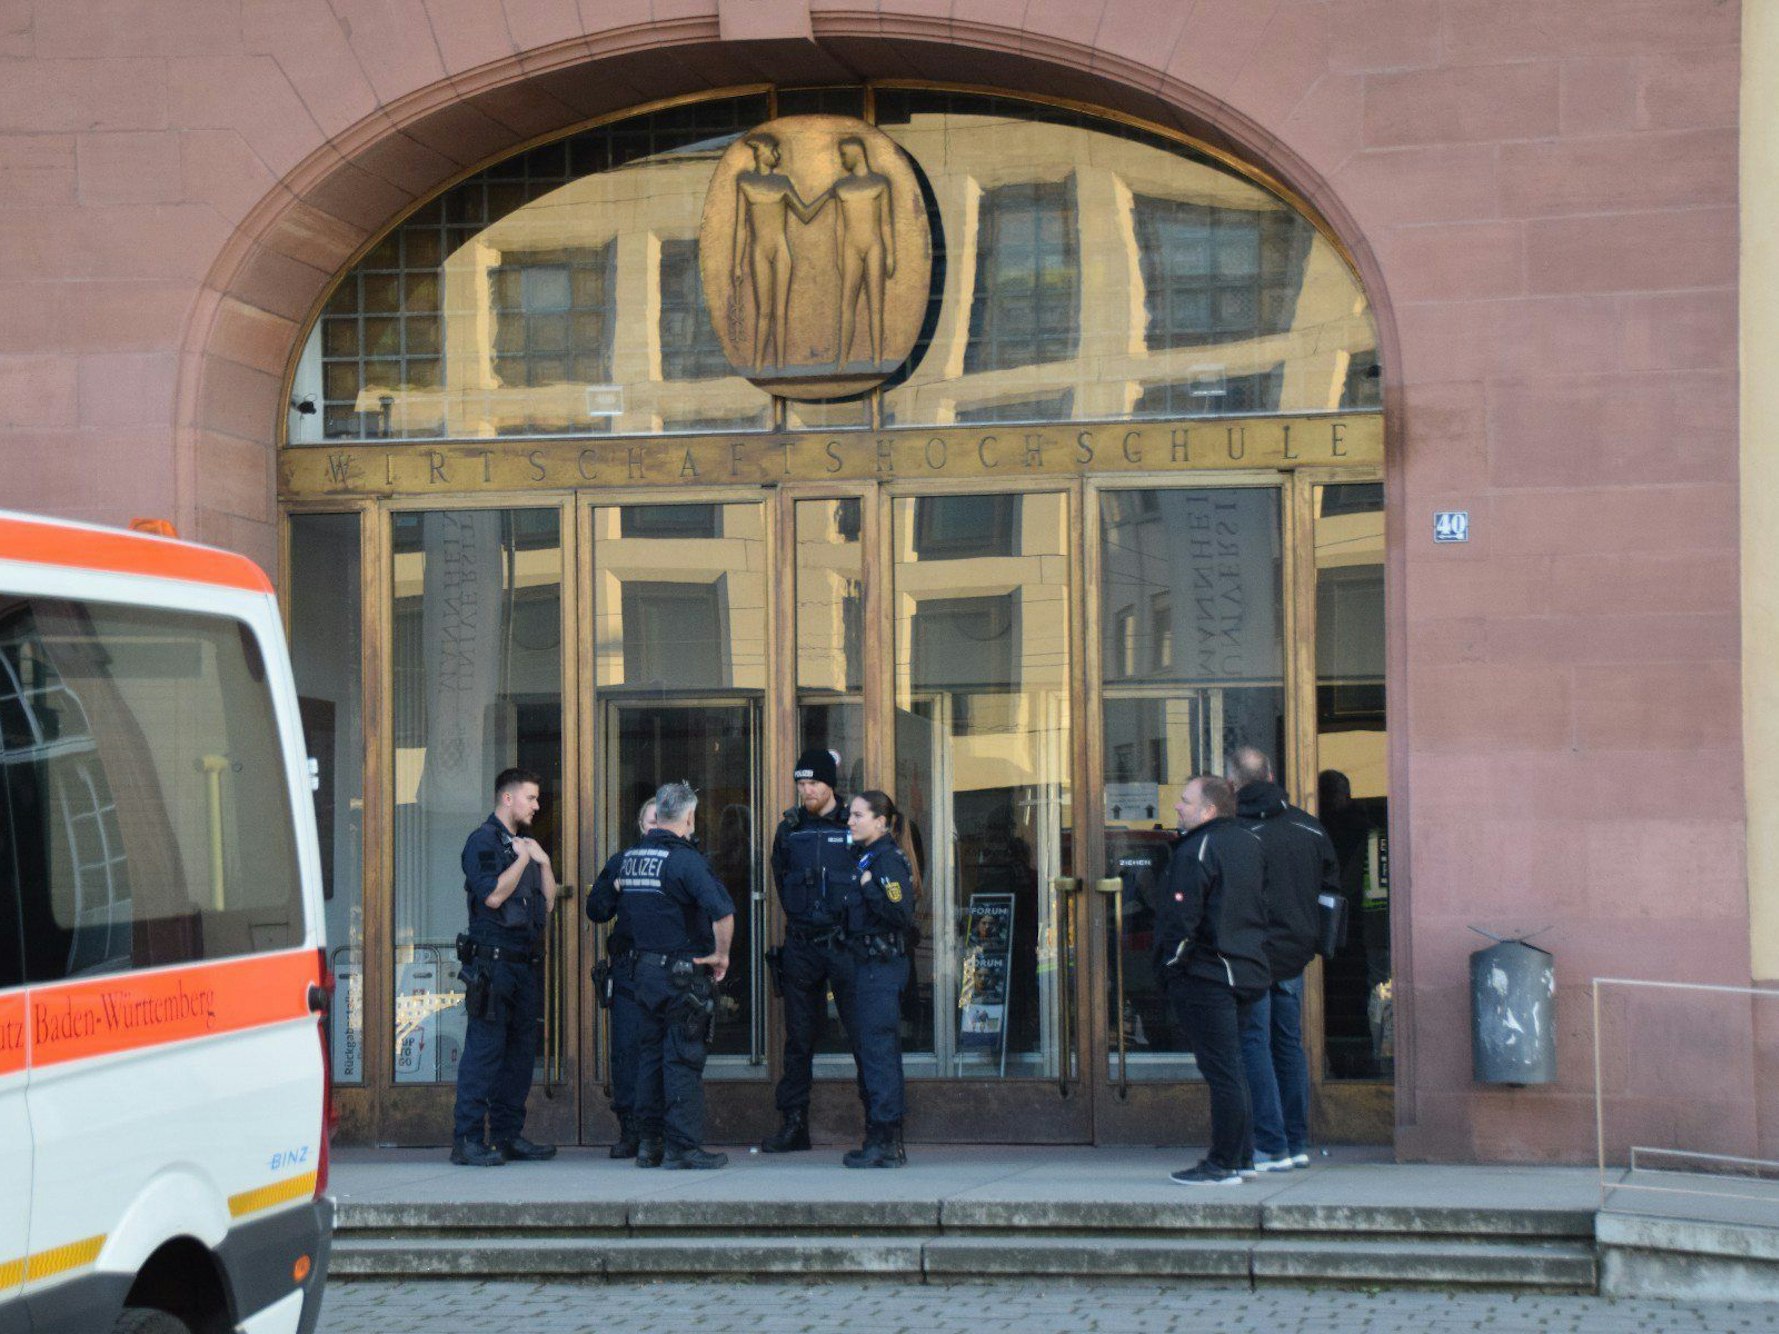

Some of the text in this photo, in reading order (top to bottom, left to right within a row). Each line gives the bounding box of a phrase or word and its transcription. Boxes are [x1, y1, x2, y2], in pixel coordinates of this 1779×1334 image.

[1436, 514, 1466, 535] 40
[620, 857, 663, 877] POLIZEI
[970, 906, 1008, 915] FORUM
[34, 979, 216, 1046] Baden-Württemberg
[269, 1145, 309, 1170] BINZ
